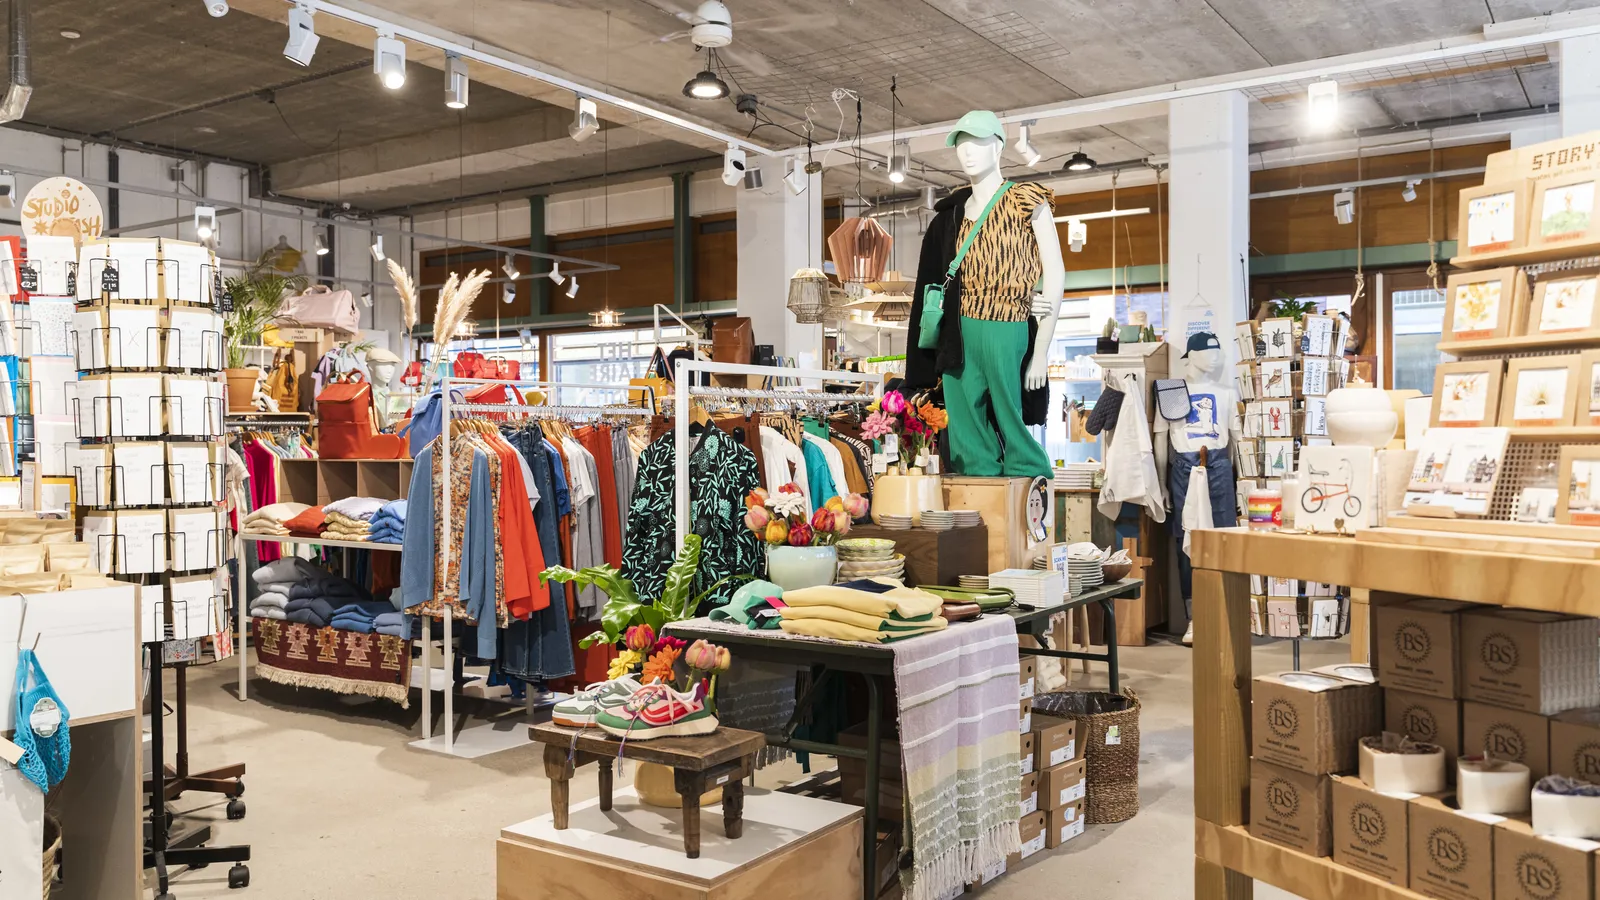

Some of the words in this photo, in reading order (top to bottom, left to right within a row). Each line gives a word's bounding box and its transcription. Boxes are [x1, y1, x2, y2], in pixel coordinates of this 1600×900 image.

[1532, 142, 1600, 170] STORY
[23, 195, 79, 219] STUDIO
[1403, 632, 1424, 652] BS
[1489, 643, 1512, 664] BS
[1274, 709, 1293, 728] BS
[1410, 714, 1431, 735] BS
[1494, 734, 1518, 757] BS
[1274, 788, 1293, 808] BS
[1358, 813, 1379, 836] BS
[1436, 838, 1459, 862] BS
[1526, 865, 1552, 890] BS
